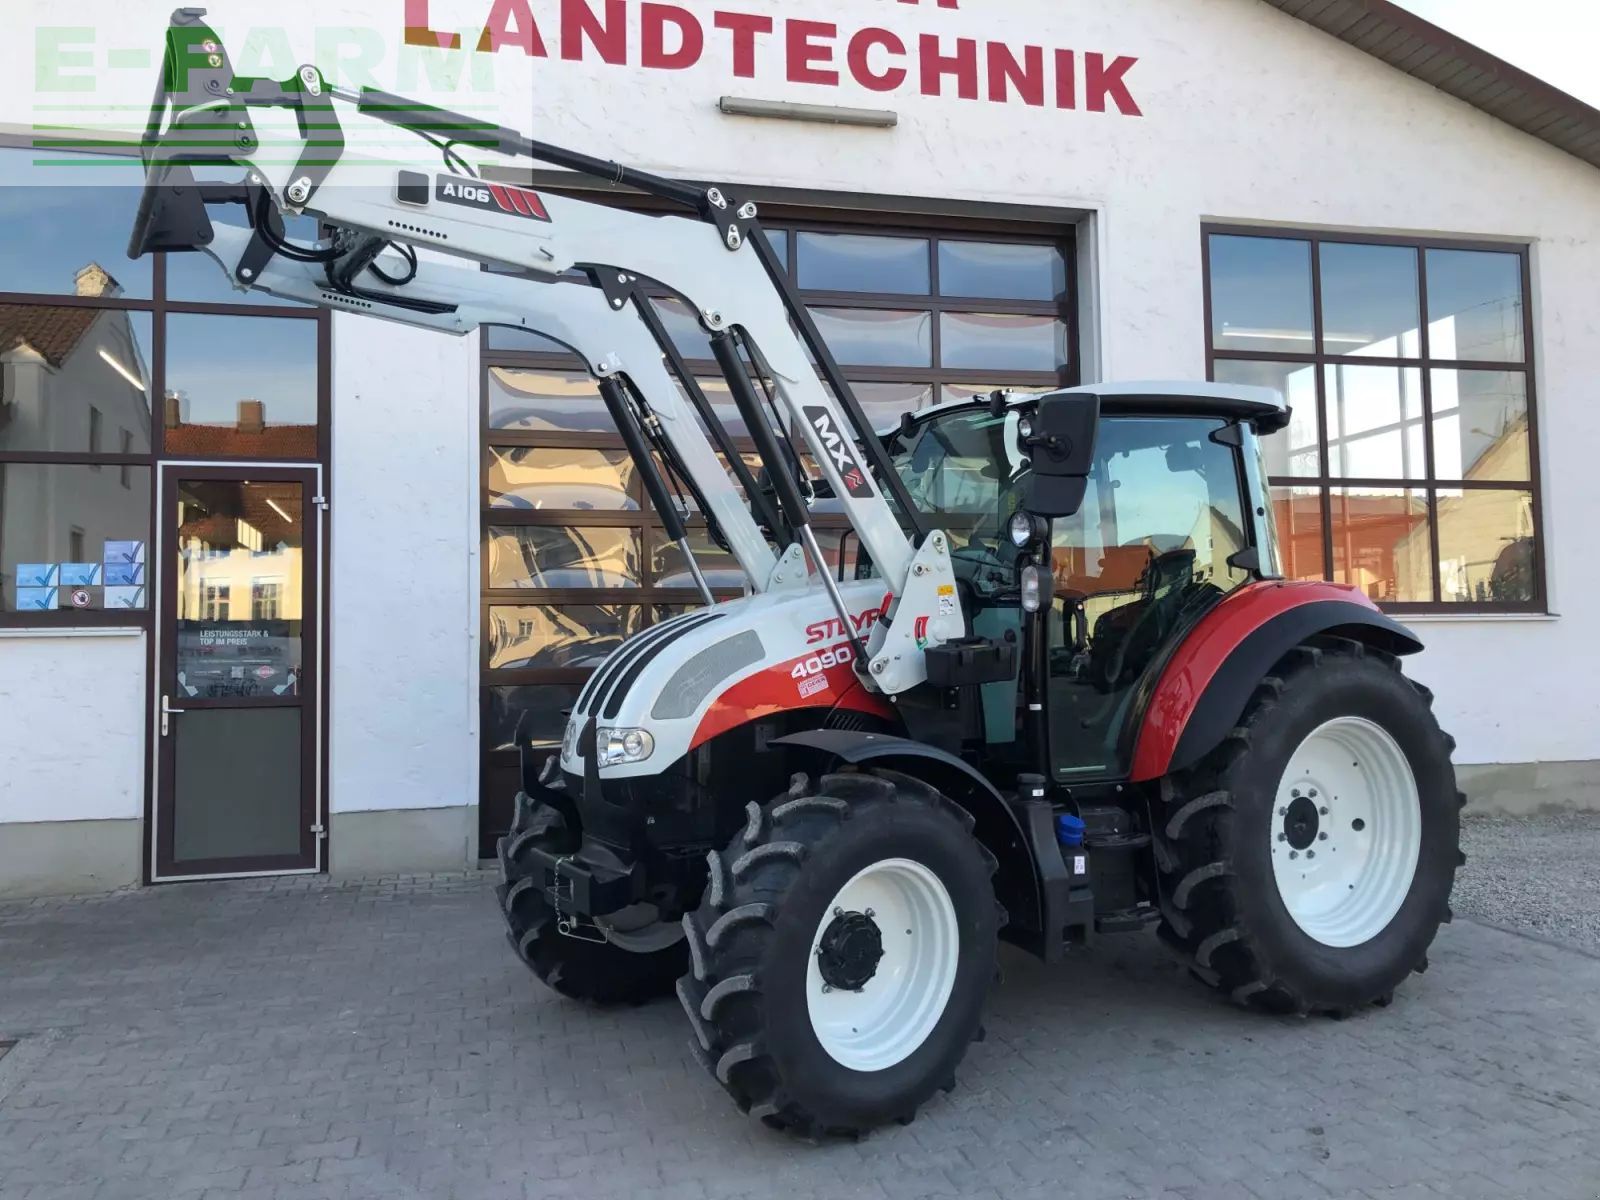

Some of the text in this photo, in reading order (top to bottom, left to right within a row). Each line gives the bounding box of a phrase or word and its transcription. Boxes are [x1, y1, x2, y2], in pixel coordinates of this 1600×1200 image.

[405, 0, 1143, 117] LANDTECHNIK
[814, 414, 853, 472] MX
[200, 638, 214, 646] TOP
[226, 638, 248, 646] PREIS
[791, 646, 852, 679] 4090
